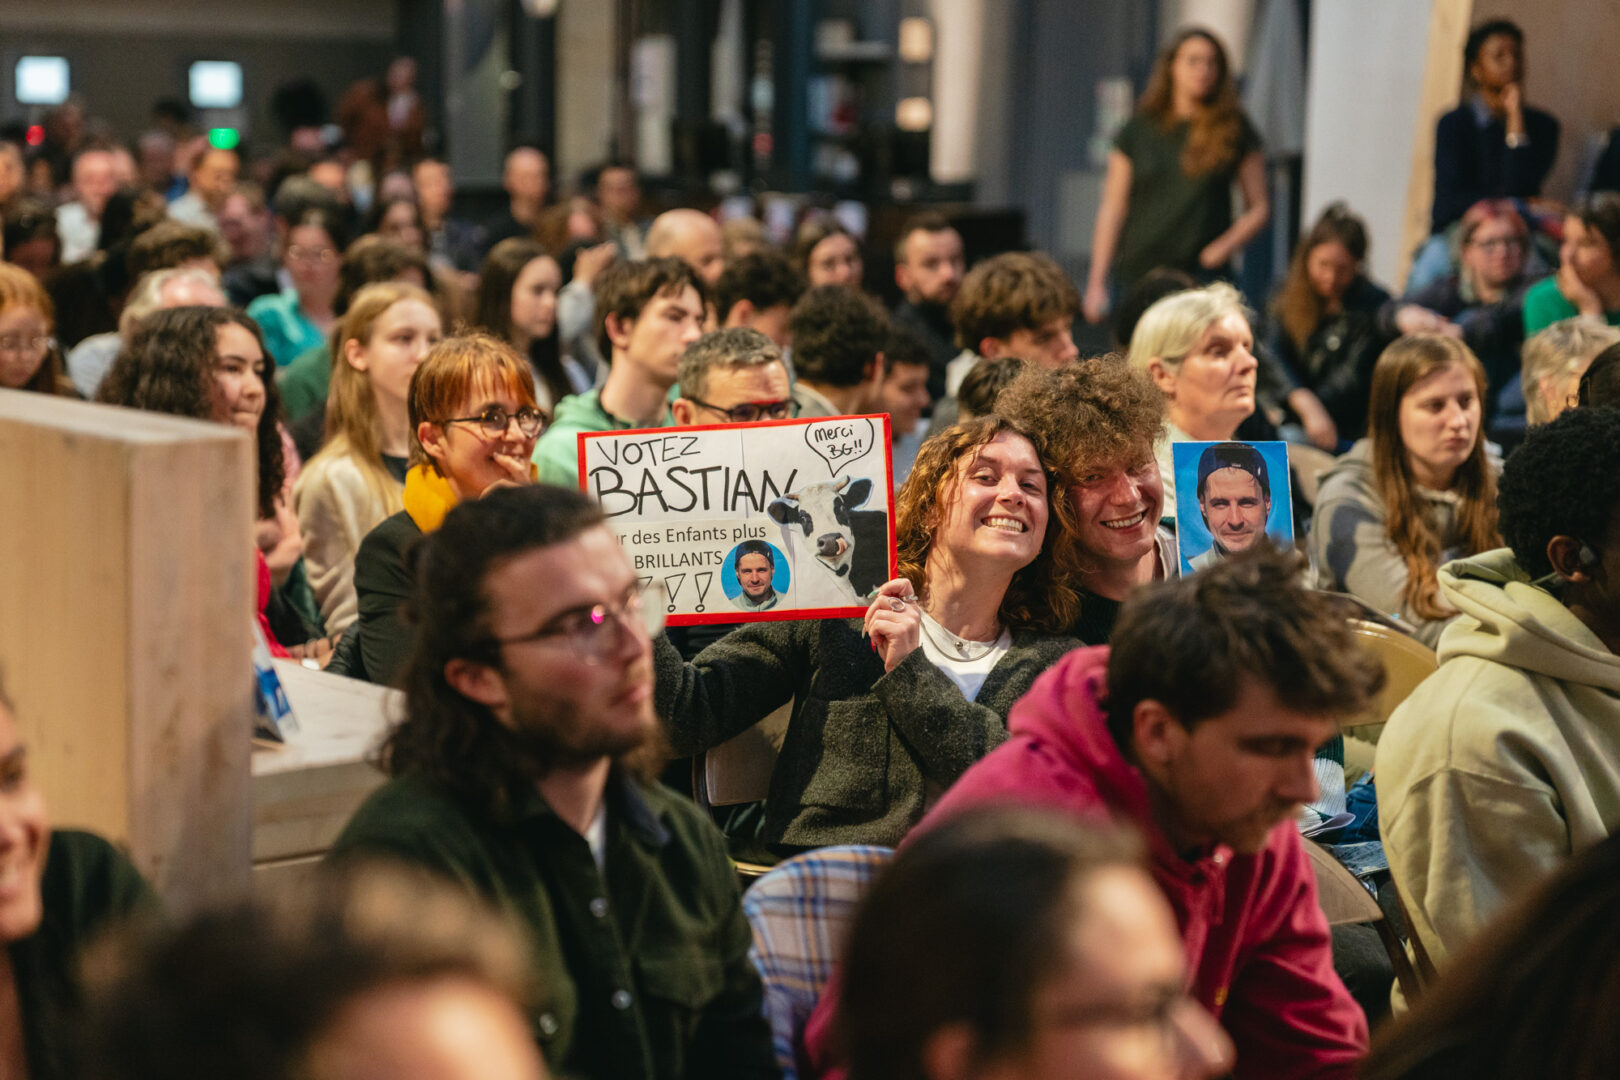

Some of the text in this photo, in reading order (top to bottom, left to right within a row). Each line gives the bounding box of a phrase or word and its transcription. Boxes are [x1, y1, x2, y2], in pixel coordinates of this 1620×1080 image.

[596, 435, 701, 466] VOTEZ
[588, 466, 798, 517] BASTIAN
[632, 529, 661, 545] des
[666, 526, 727, 543] Enfants
[733, 524, 767, 542] plus
[634, 550, 723, 570] BRILLANTS
